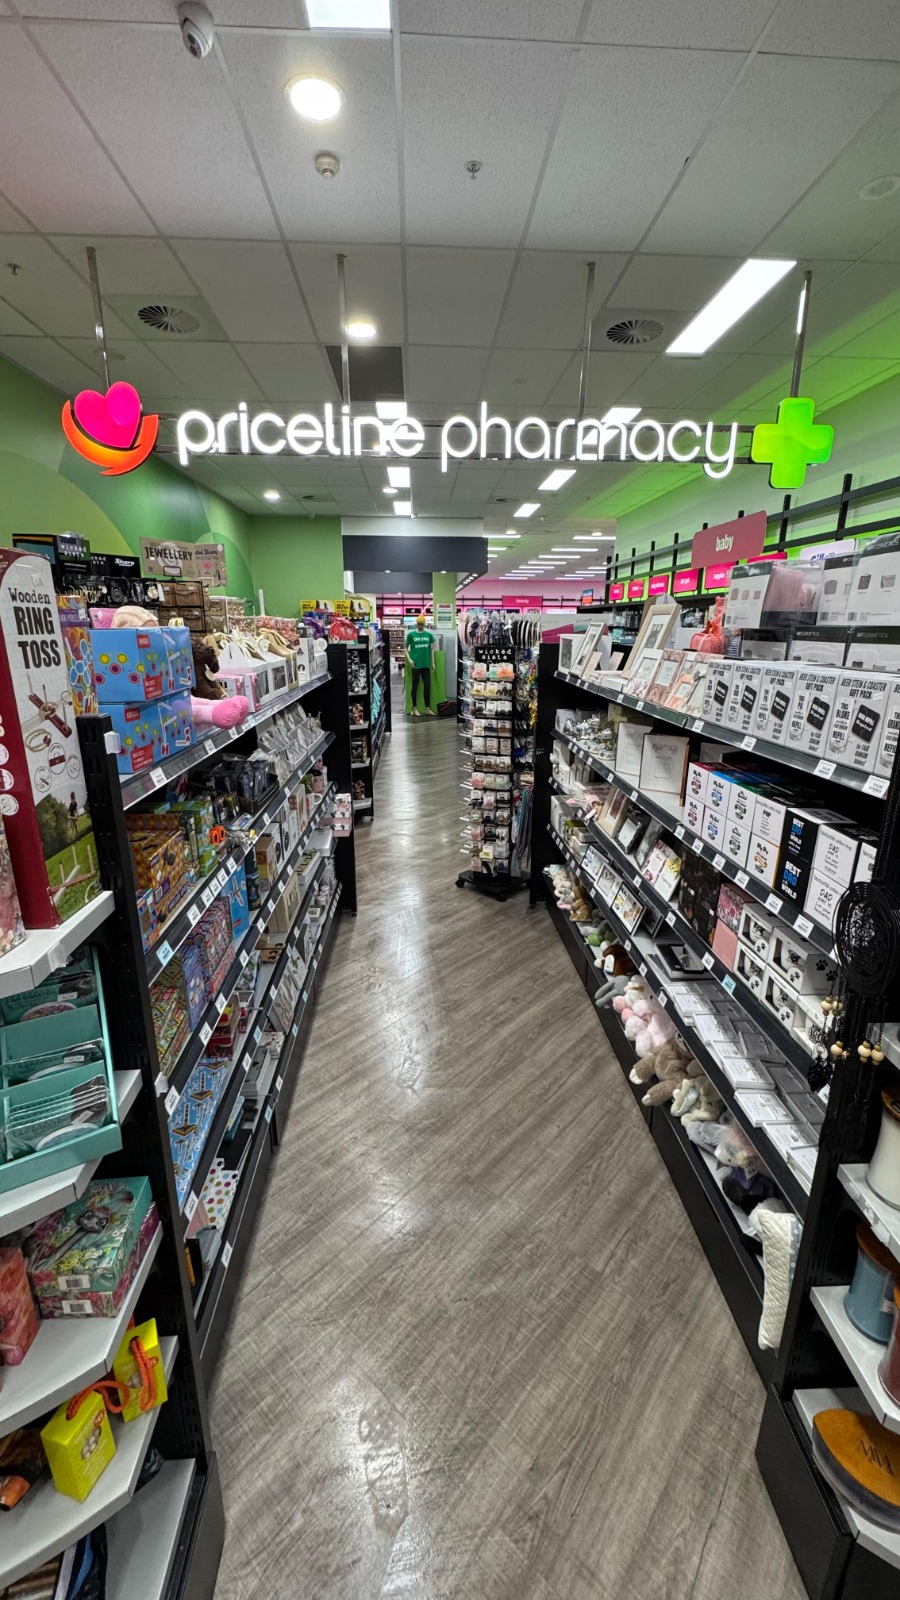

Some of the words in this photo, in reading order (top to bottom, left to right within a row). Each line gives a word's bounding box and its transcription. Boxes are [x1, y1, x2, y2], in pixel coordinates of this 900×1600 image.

[177, 402, 425, 466] priceline
[441, 401, 738, 478] pharmacy
[60, 544, 87, 553] wicked
[715, 534, 734, 552] baby
[144, 547, 193, 561] JEWELLERY
[8, 587, 51, 604] Wooden
[13, 606, 55, 635] RING
[18, 639, 61, 669] TOSS
[807, 674, 817, 682] STEIN
[820, 675, 836, 685] COASTER
[841, 678, 851, 687] BEER
[851, 679, 863, 688] STEIN
[866, 681, 887, 691] COASTER
[806, 682, 814, 690] GIFT
[813, 684, 824, 692] PACK
[849, 689, 860, 697] GIFT
[860, 690, 872, 699] PACK
[836, 709, 850, 720] BLOKE
[792, 720, 802, 729] REFILL
[832, 731, 845, 740] REFILL
[793, 818, 804, 828] BEST
[829, 843, 840, 853] DAD
[785, 861, 801, 877] BEST
[783, 870, 798, 886] DAD
[781, 884, 797, 899] WORLD
[820, 889, 833, 902] DAD
[822, 907, 831, 915] your
